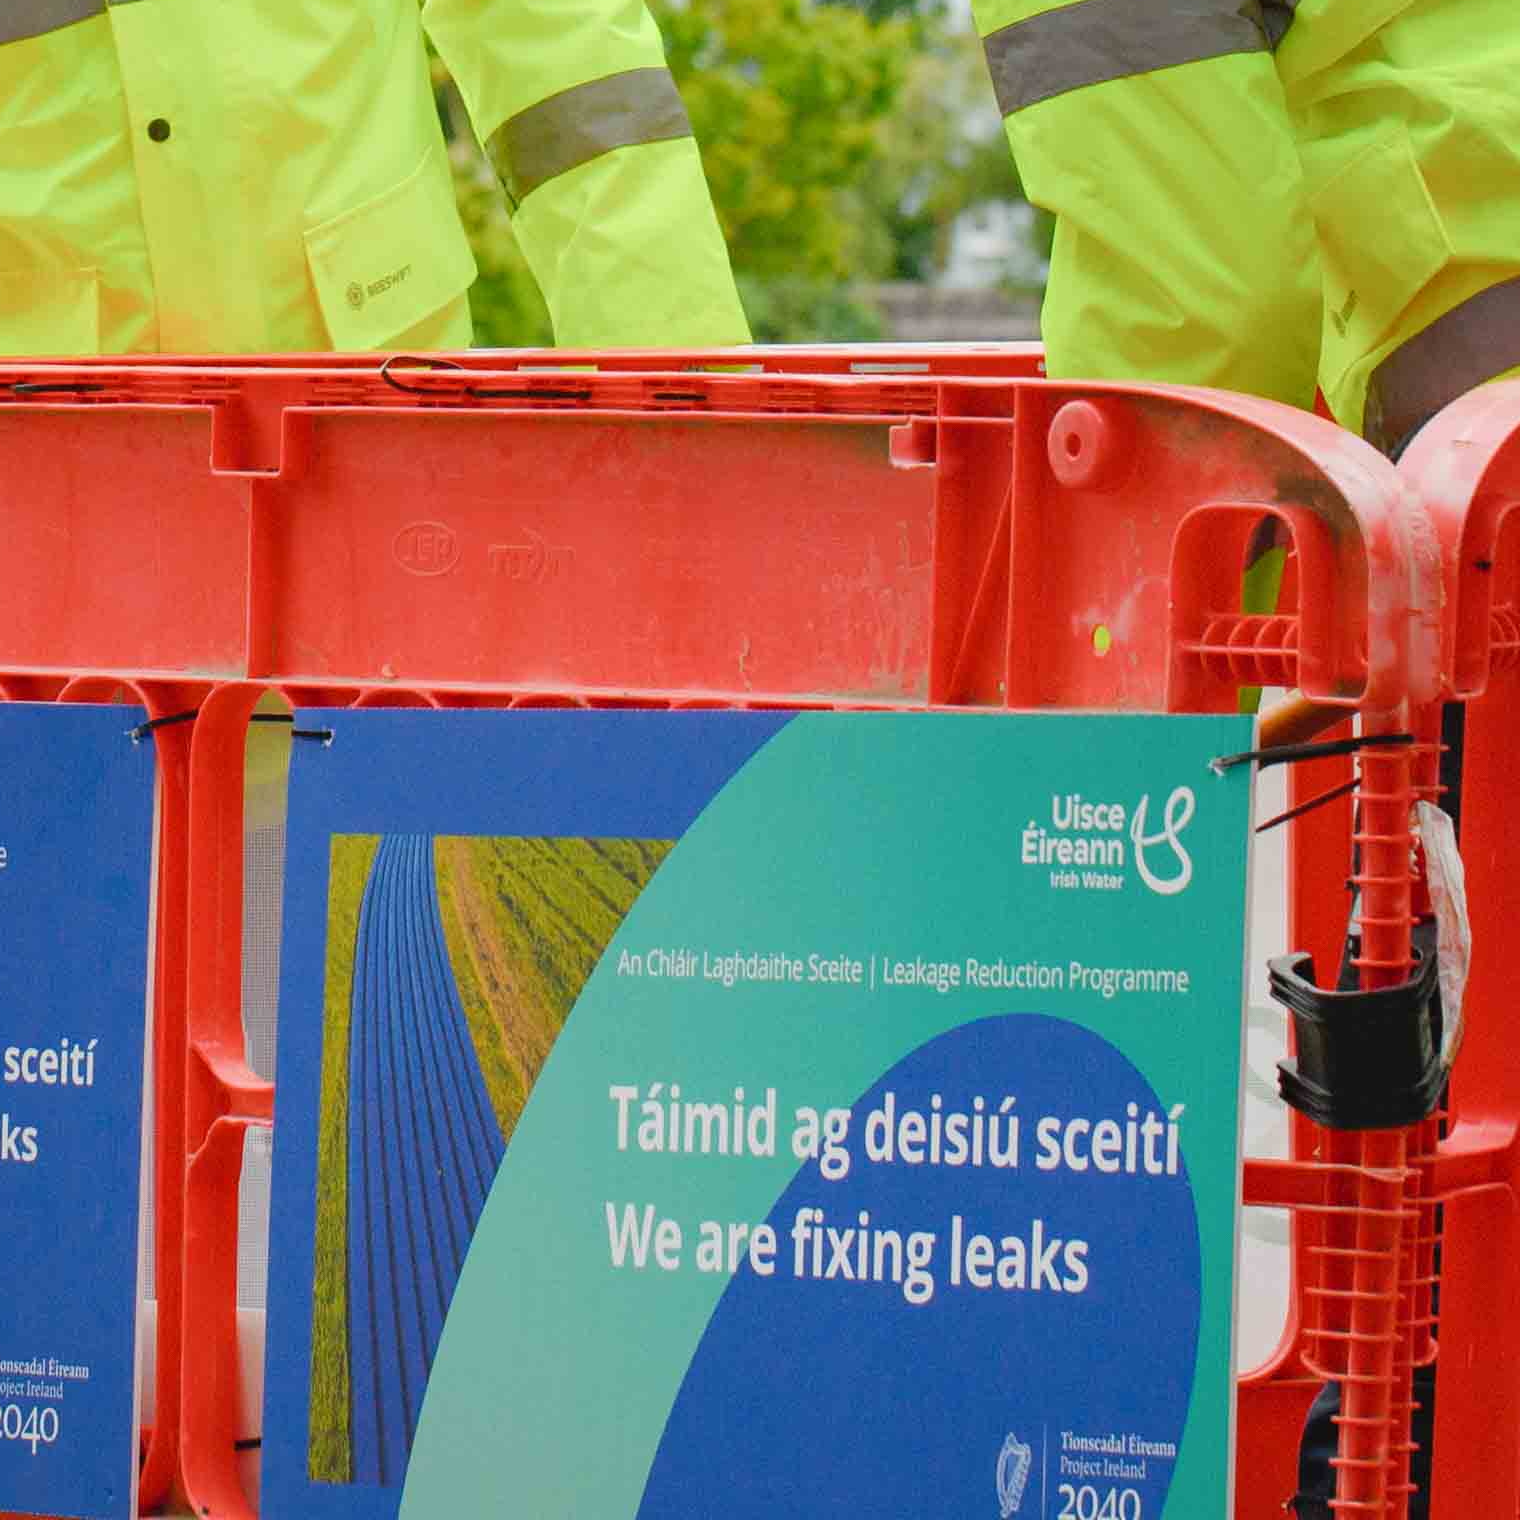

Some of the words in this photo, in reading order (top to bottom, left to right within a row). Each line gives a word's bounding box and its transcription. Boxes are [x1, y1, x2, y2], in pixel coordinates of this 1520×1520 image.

[1052, 793, 1125, 830] Uisce
[1021, 820, 1125, 865] Éireann
[1050, 870, 1080, 889] Irish
[1082, 871, 1125, 889] Water
[617, 949, 642, 977] An
[647, 948, 698, 977] Chláir
[703, 951, 803, 987] Laghdaithe
[807, 953, 863, 983] Sceite
[883, 955, 961, 993] Leakage
[965, 957, 1064, 990] Reduction
[1069, 960, 1190, 998] Programme
[3, 1038, 99, 1086] sceití
[609, 1083, 776, 1156] Táimid
[791, 1105, 852, 1180] ag
[865, 1092, 1020, 1168] deisiú
[1035, 1102, 1185, 1176] sceití
[605, 1201, 683, 1273] We
[696, 1217, 777, 1277] are
[791, 1207, 936, 1304] fixing
[951, 1215, 1090, 1294] leaks
[48, 1357, 90, 1380] Éireann
[26, 1379, 64, 1400] Ireland
[1060, 1430, 1126, 1456] Tionscadal
[1129, 1432, 1177, 1458] Éireann
[1059, 1455, 1101, 1479] Project
[1104, 1456, 1146, 1480] Ireland
[1056, 1482, 1142, 1520] 2040
